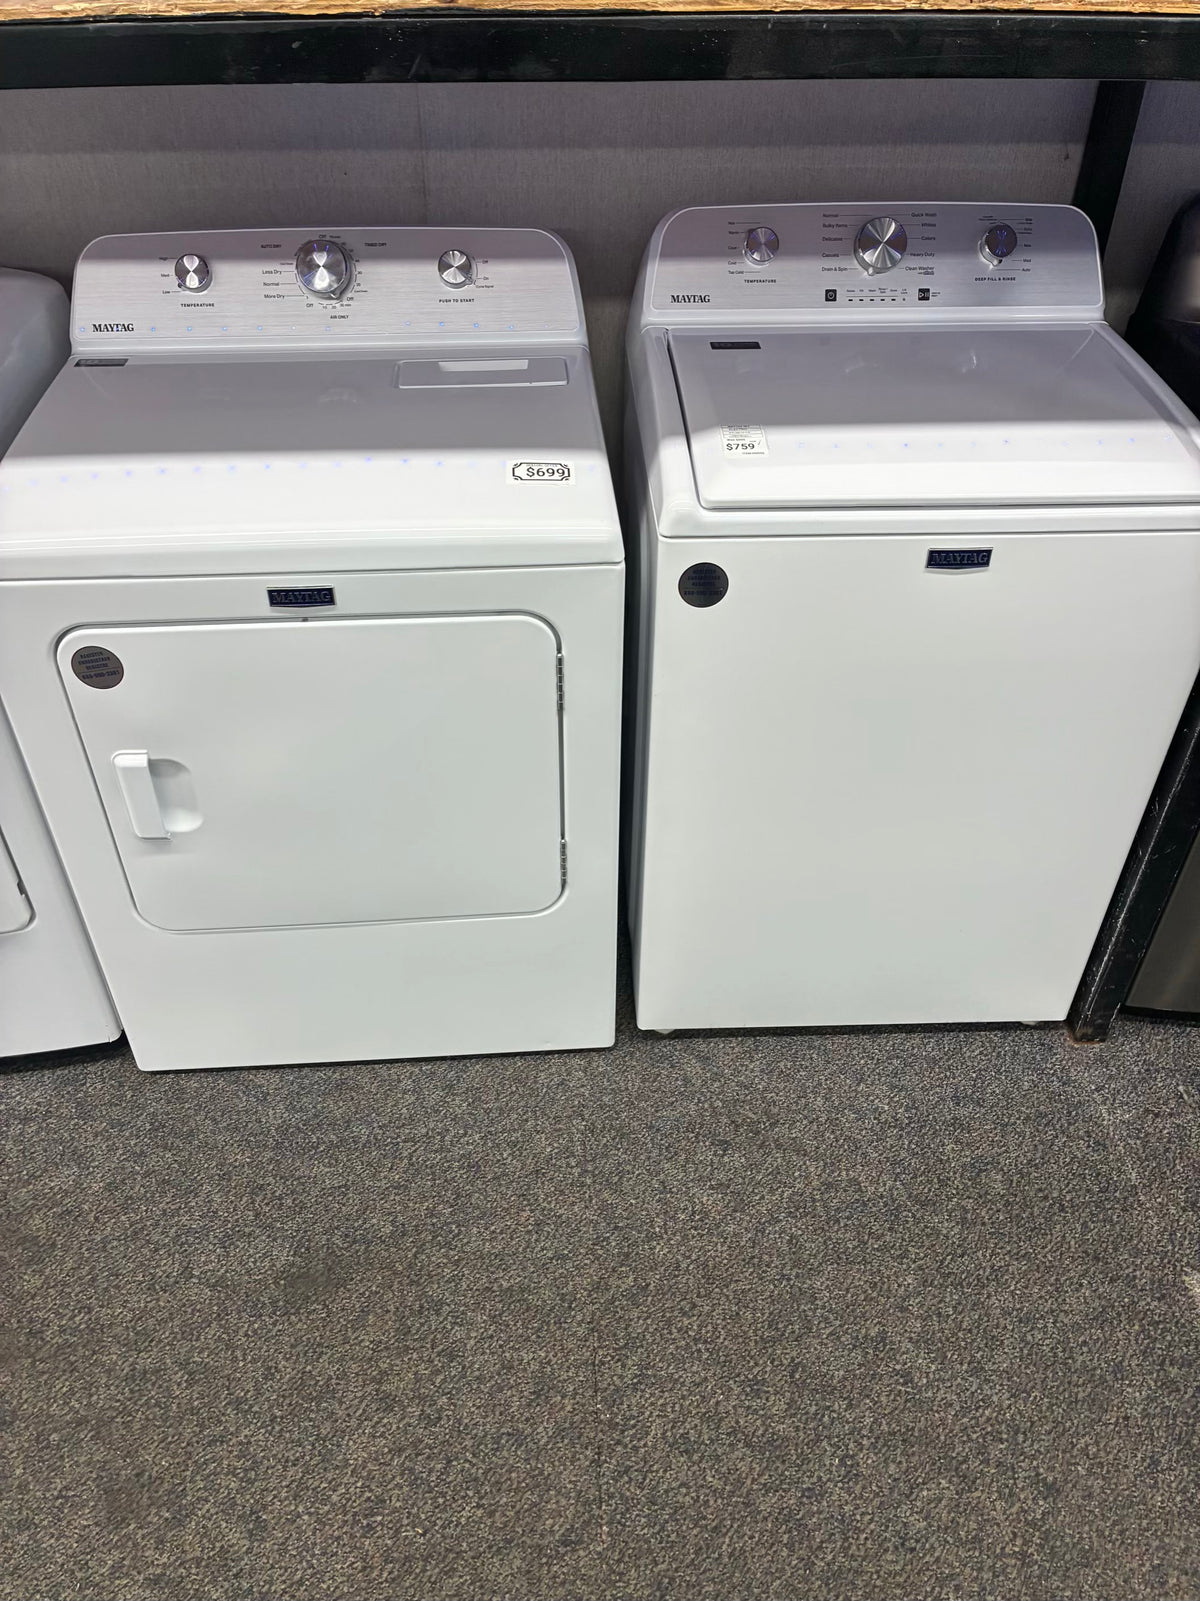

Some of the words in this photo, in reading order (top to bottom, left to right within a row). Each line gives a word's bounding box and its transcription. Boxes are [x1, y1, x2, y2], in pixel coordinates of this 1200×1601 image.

[670, 294, 711, 304] MAYTAG
[92, 323, 134, 332] MAYTAG
[726, 443, 755, 451] $759
[526, 466, 566, 478] $699
[930, 552, 988, 564] MAYTAG
[271, 591, 330, 603] MAYTAG
